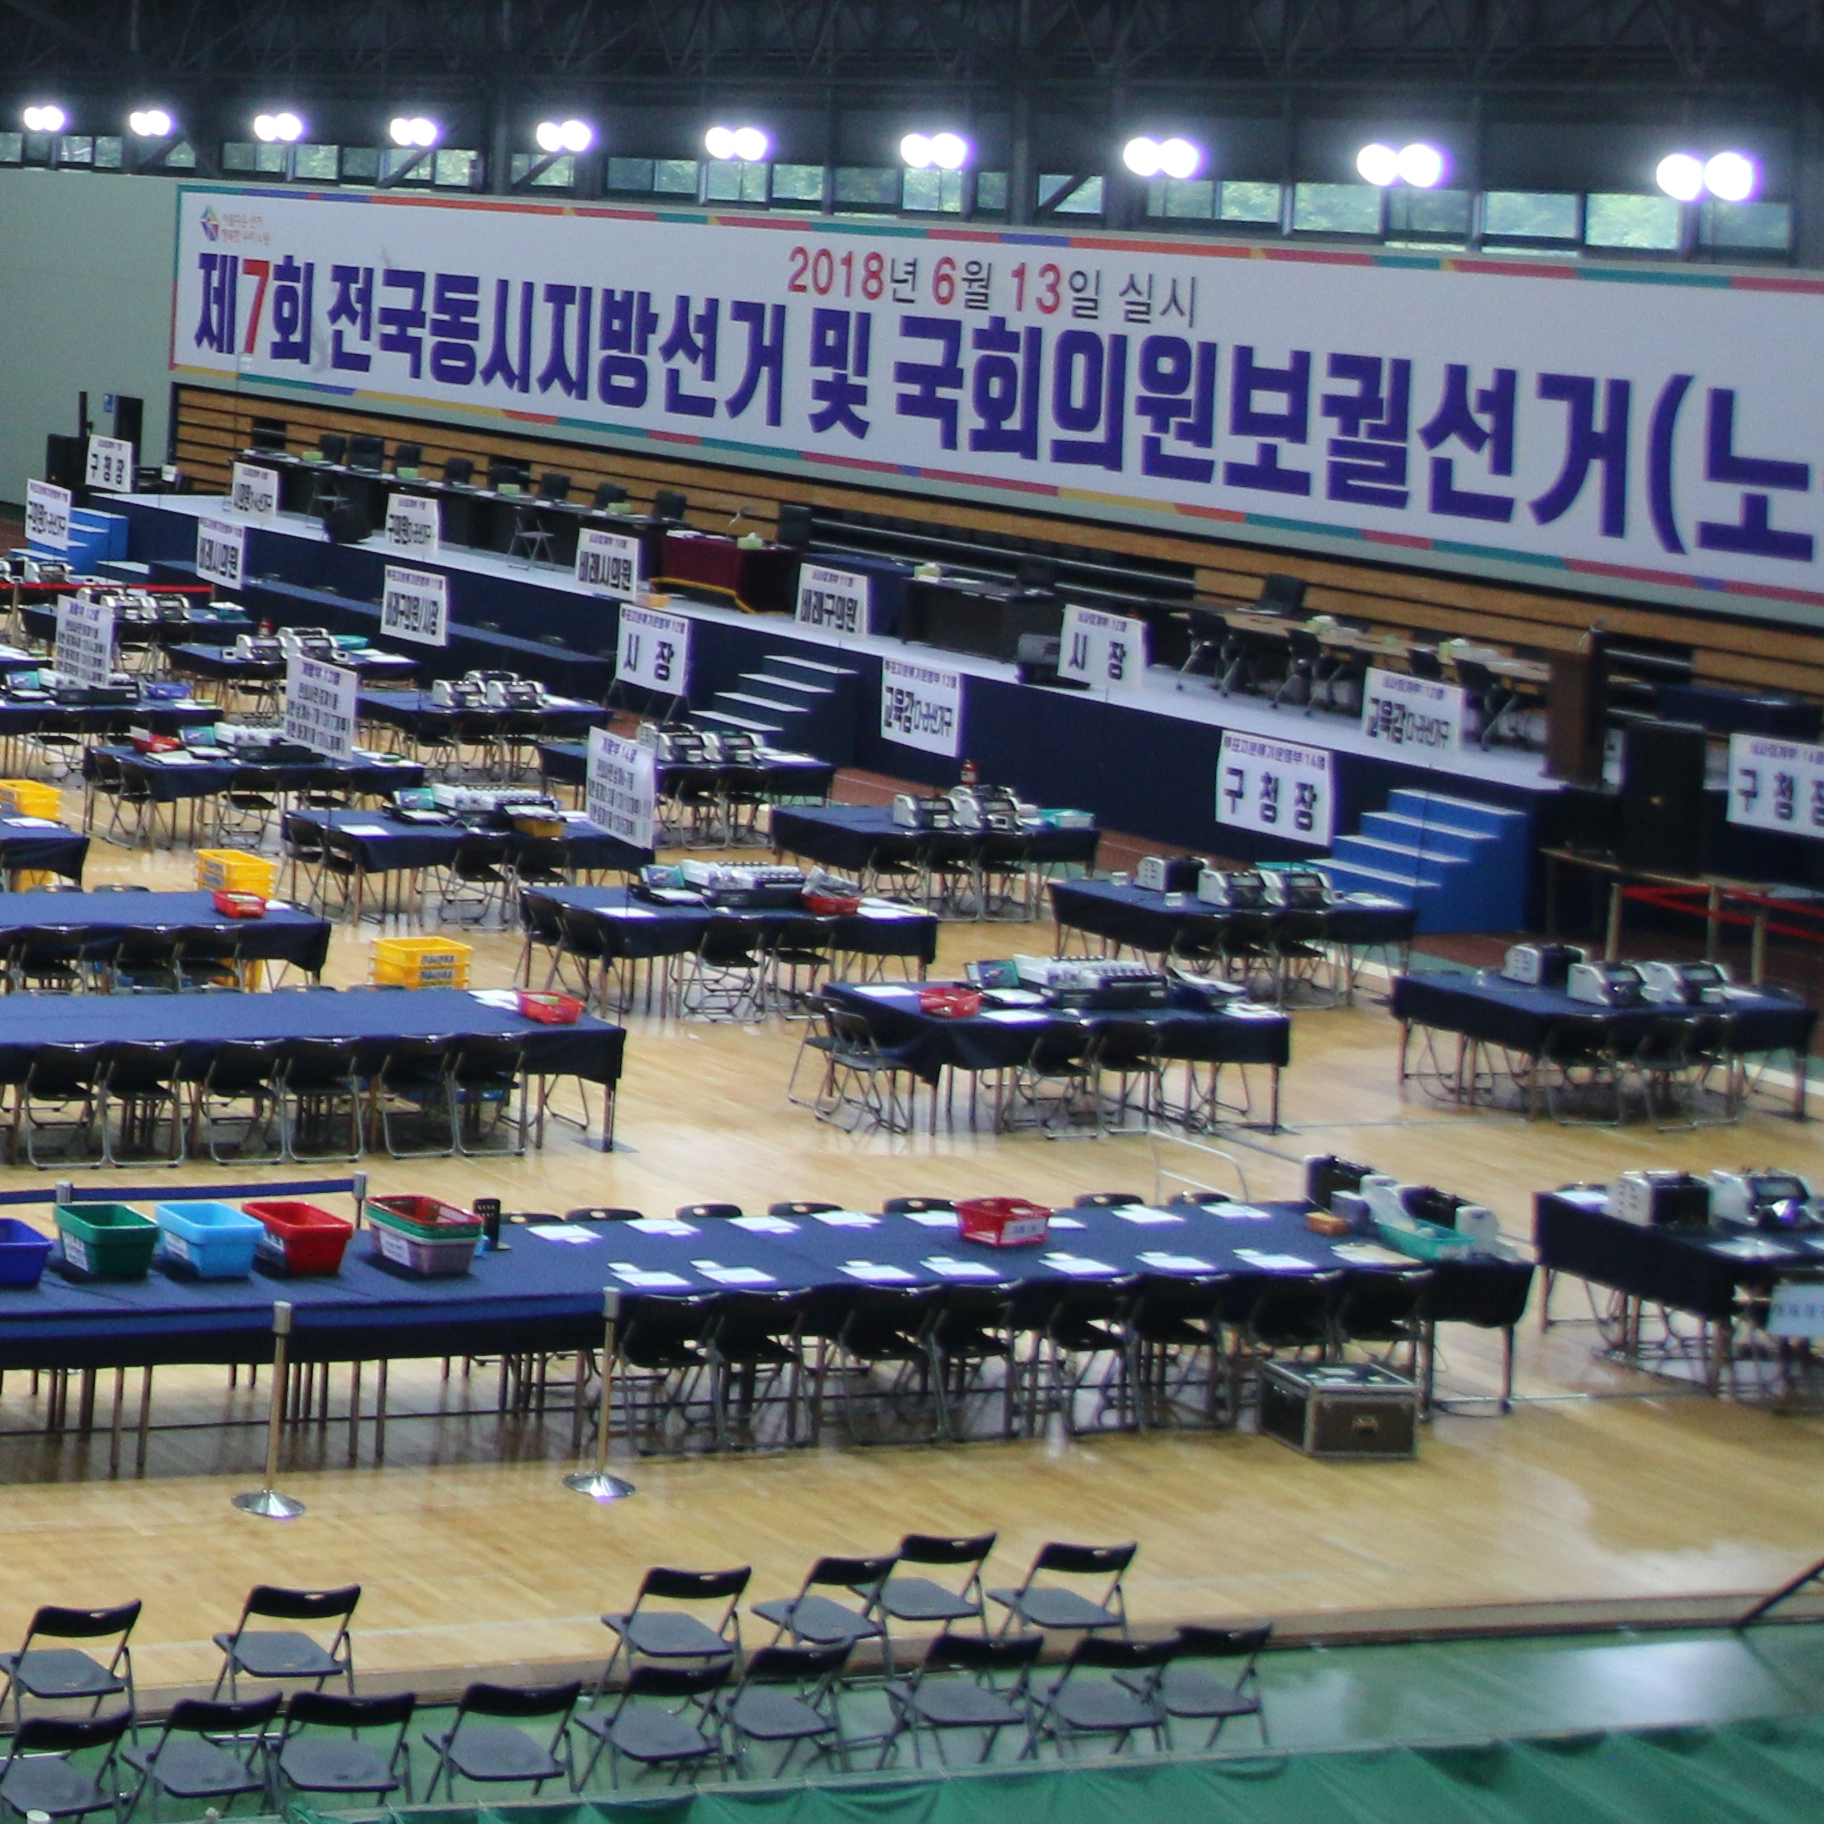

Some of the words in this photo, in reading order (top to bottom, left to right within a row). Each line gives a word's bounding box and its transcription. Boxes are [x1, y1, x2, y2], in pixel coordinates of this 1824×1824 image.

[787, 246, 918, 305] 2018년
[932, 256, 993, 312] 6월
[1010, 261, 1102, 321] 13일
[1118, 272, 1197, 329] 실시
[194, 251, 315, 367] 제7회
[327, 284, 787, 428] 전국동시지방선거
[808, 307, 871, 440] 및
[579, 551, 632, 592] 비례시의원
